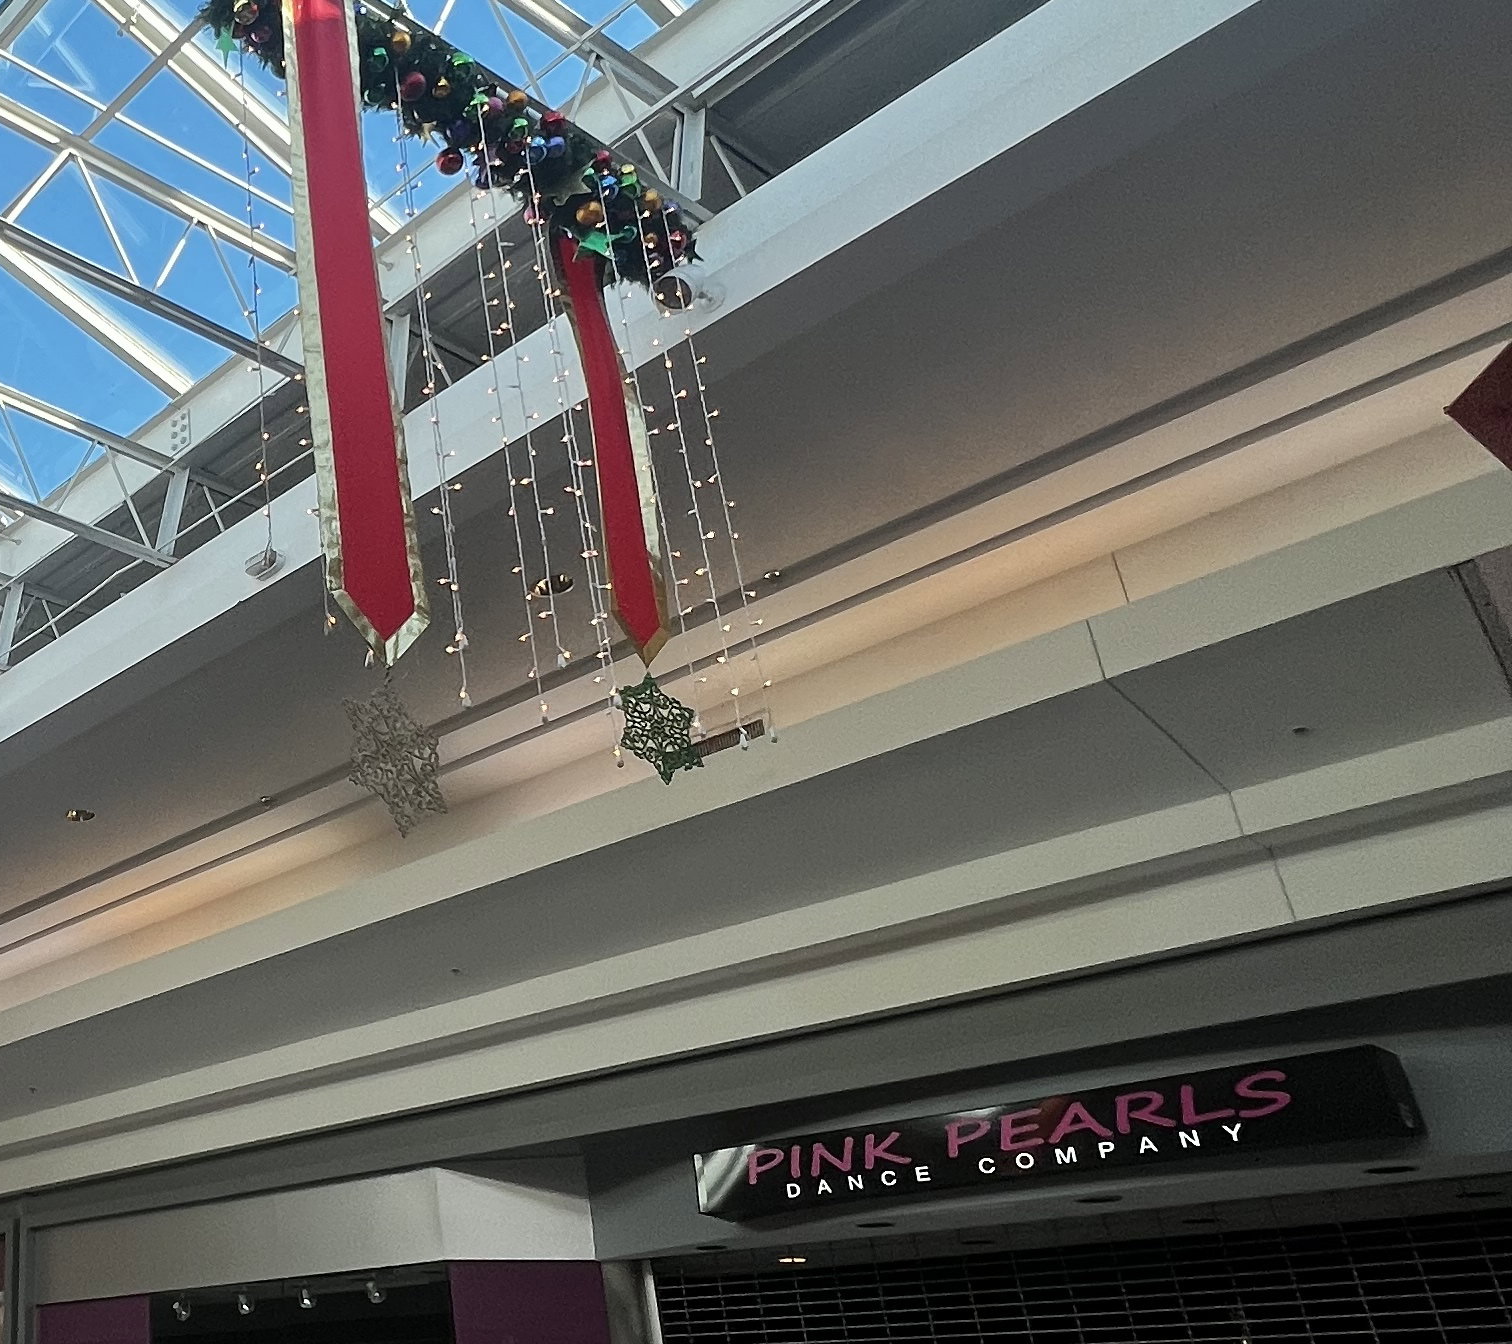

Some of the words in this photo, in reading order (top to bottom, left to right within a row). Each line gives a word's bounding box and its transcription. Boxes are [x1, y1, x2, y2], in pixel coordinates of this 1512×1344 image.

[748, 1131, 912, 1185] PINK
[944, 1070, 1291, 1158] PEARLS
[786, 1165, 932, 1198] DANCE
[978, 1123, 1242, 1174] COMPANY
